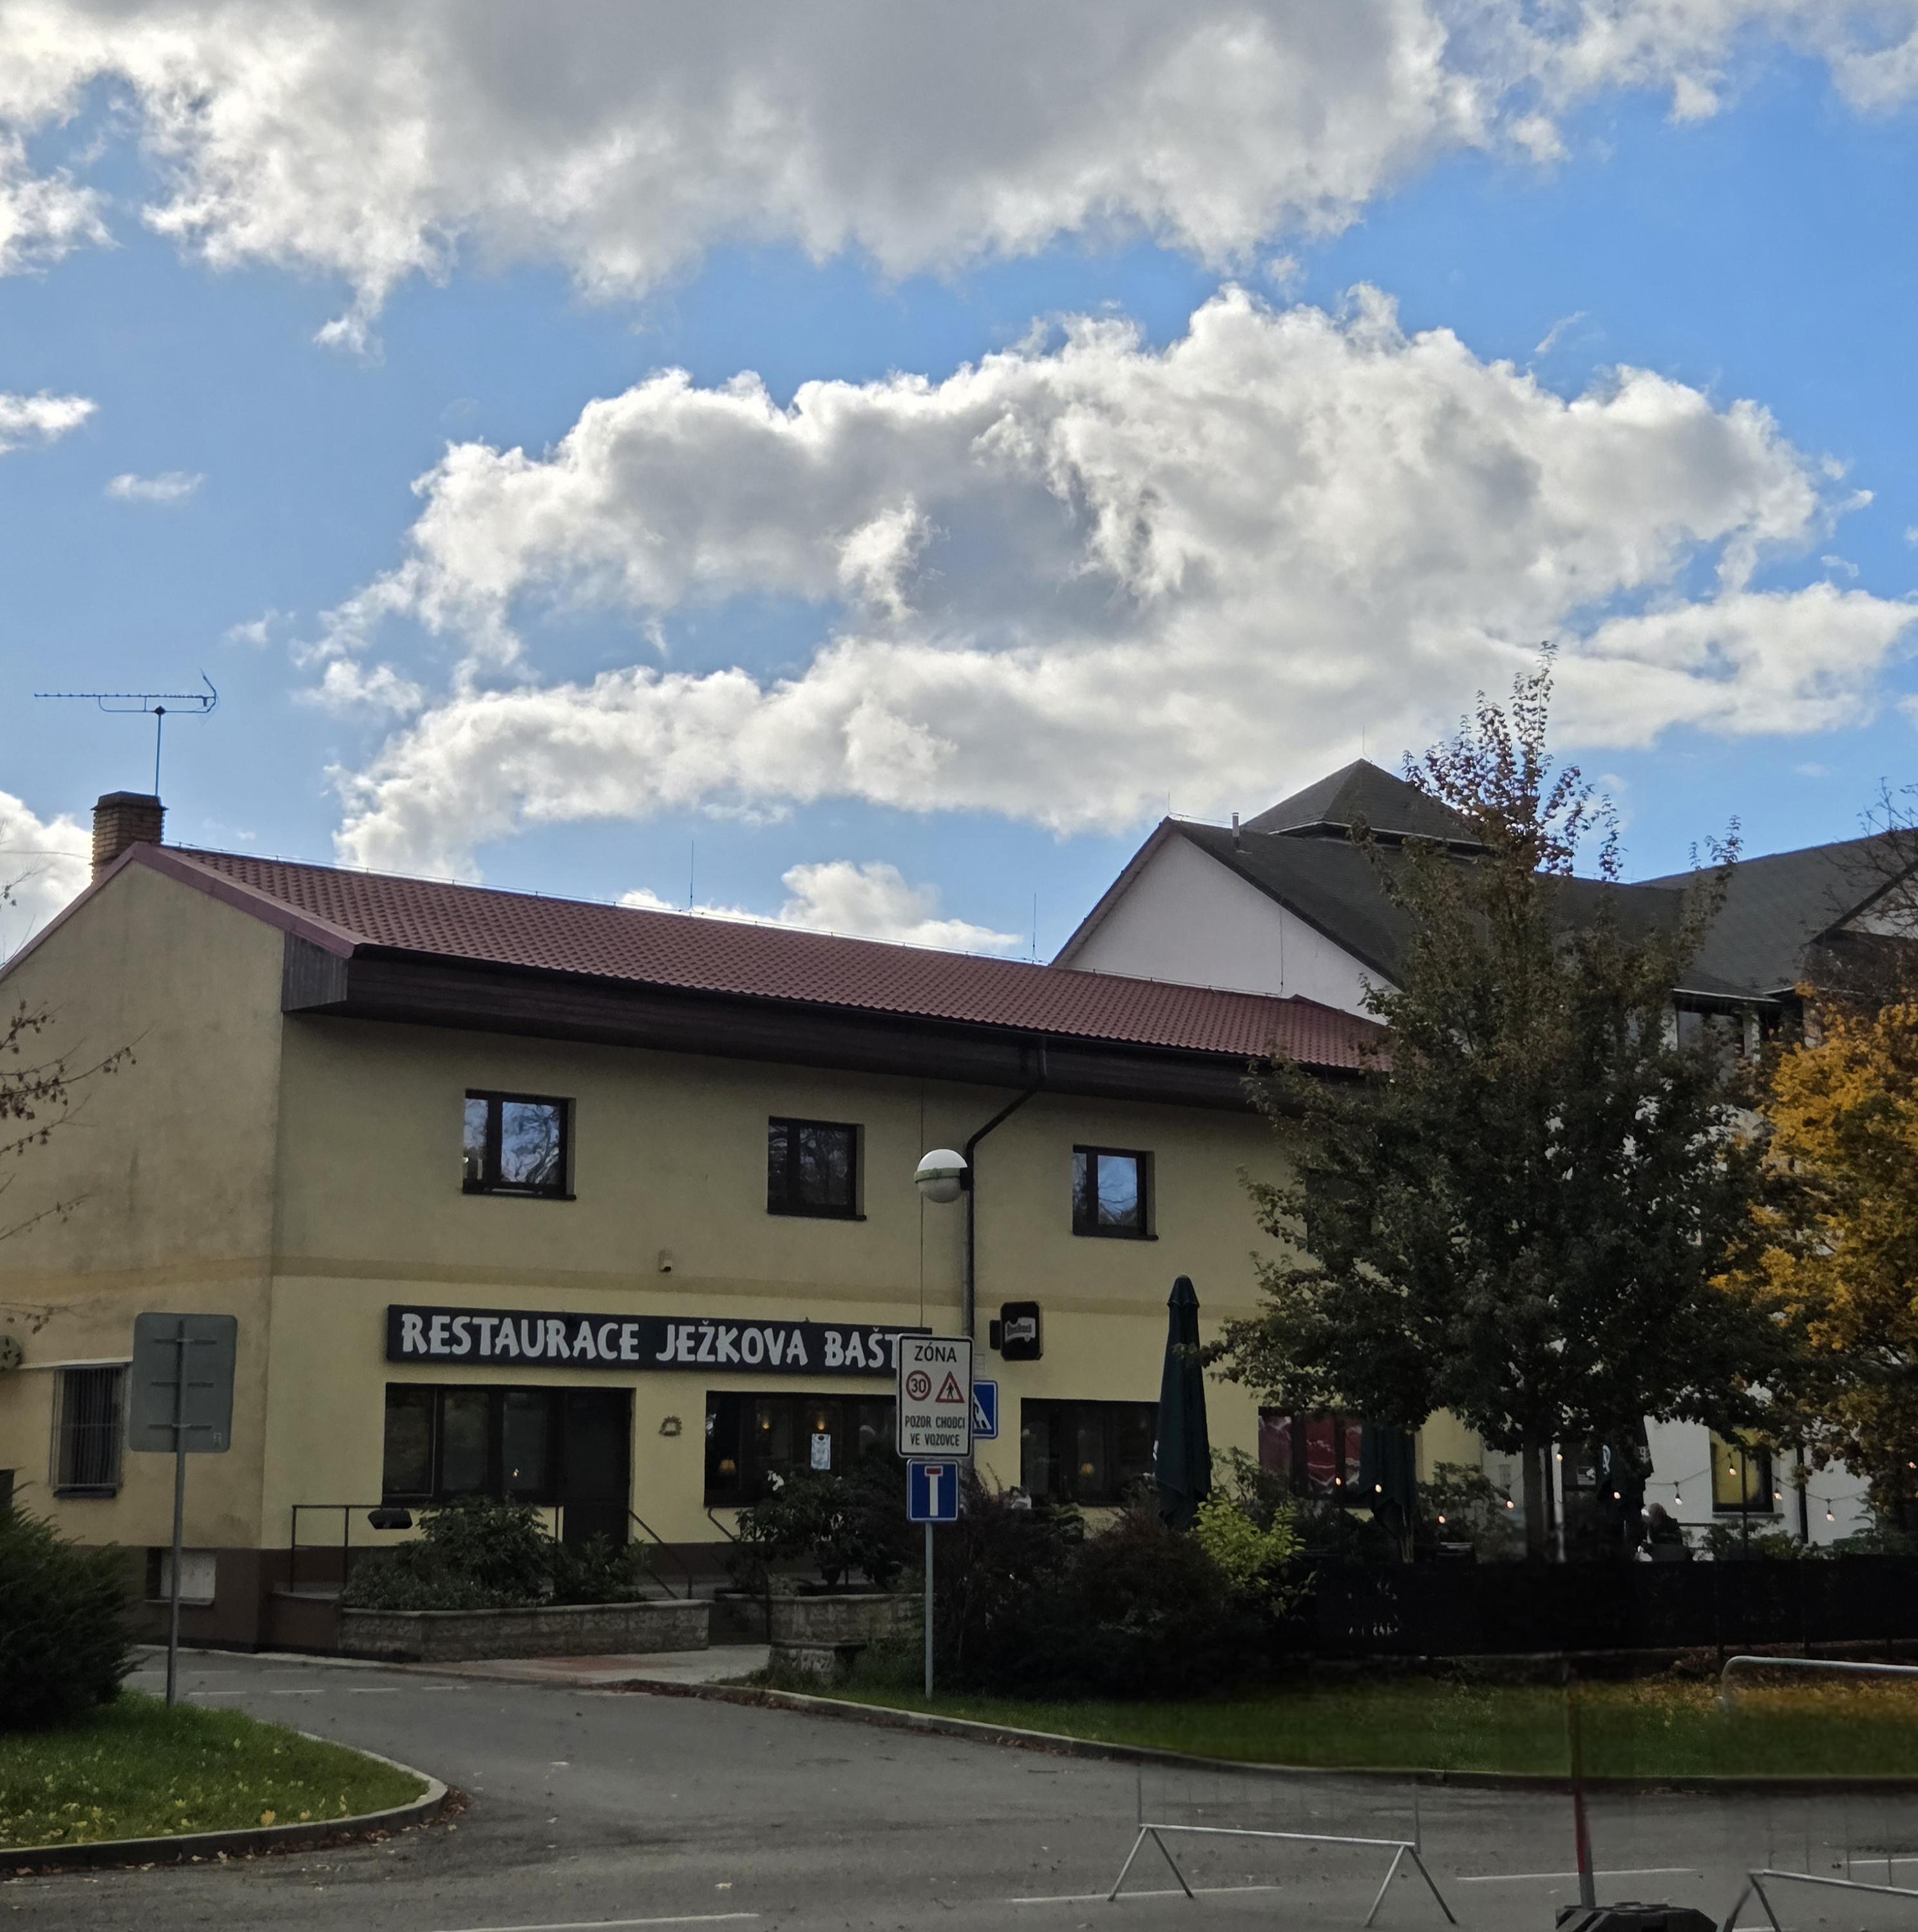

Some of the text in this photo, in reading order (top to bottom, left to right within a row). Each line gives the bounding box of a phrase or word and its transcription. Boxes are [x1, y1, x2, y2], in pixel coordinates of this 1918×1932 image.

[402, 1313, 898, 1368] RESTAURACE JEŽKOVA BAŠT
[915, 1342, 956, 1363] ZÓNA
[911, 1378, 926, 1393] 30
[905, 1416, 965, 1429] POZOR CHODCI
[910, 1433, 960, 1446] VE VOZOVCE
